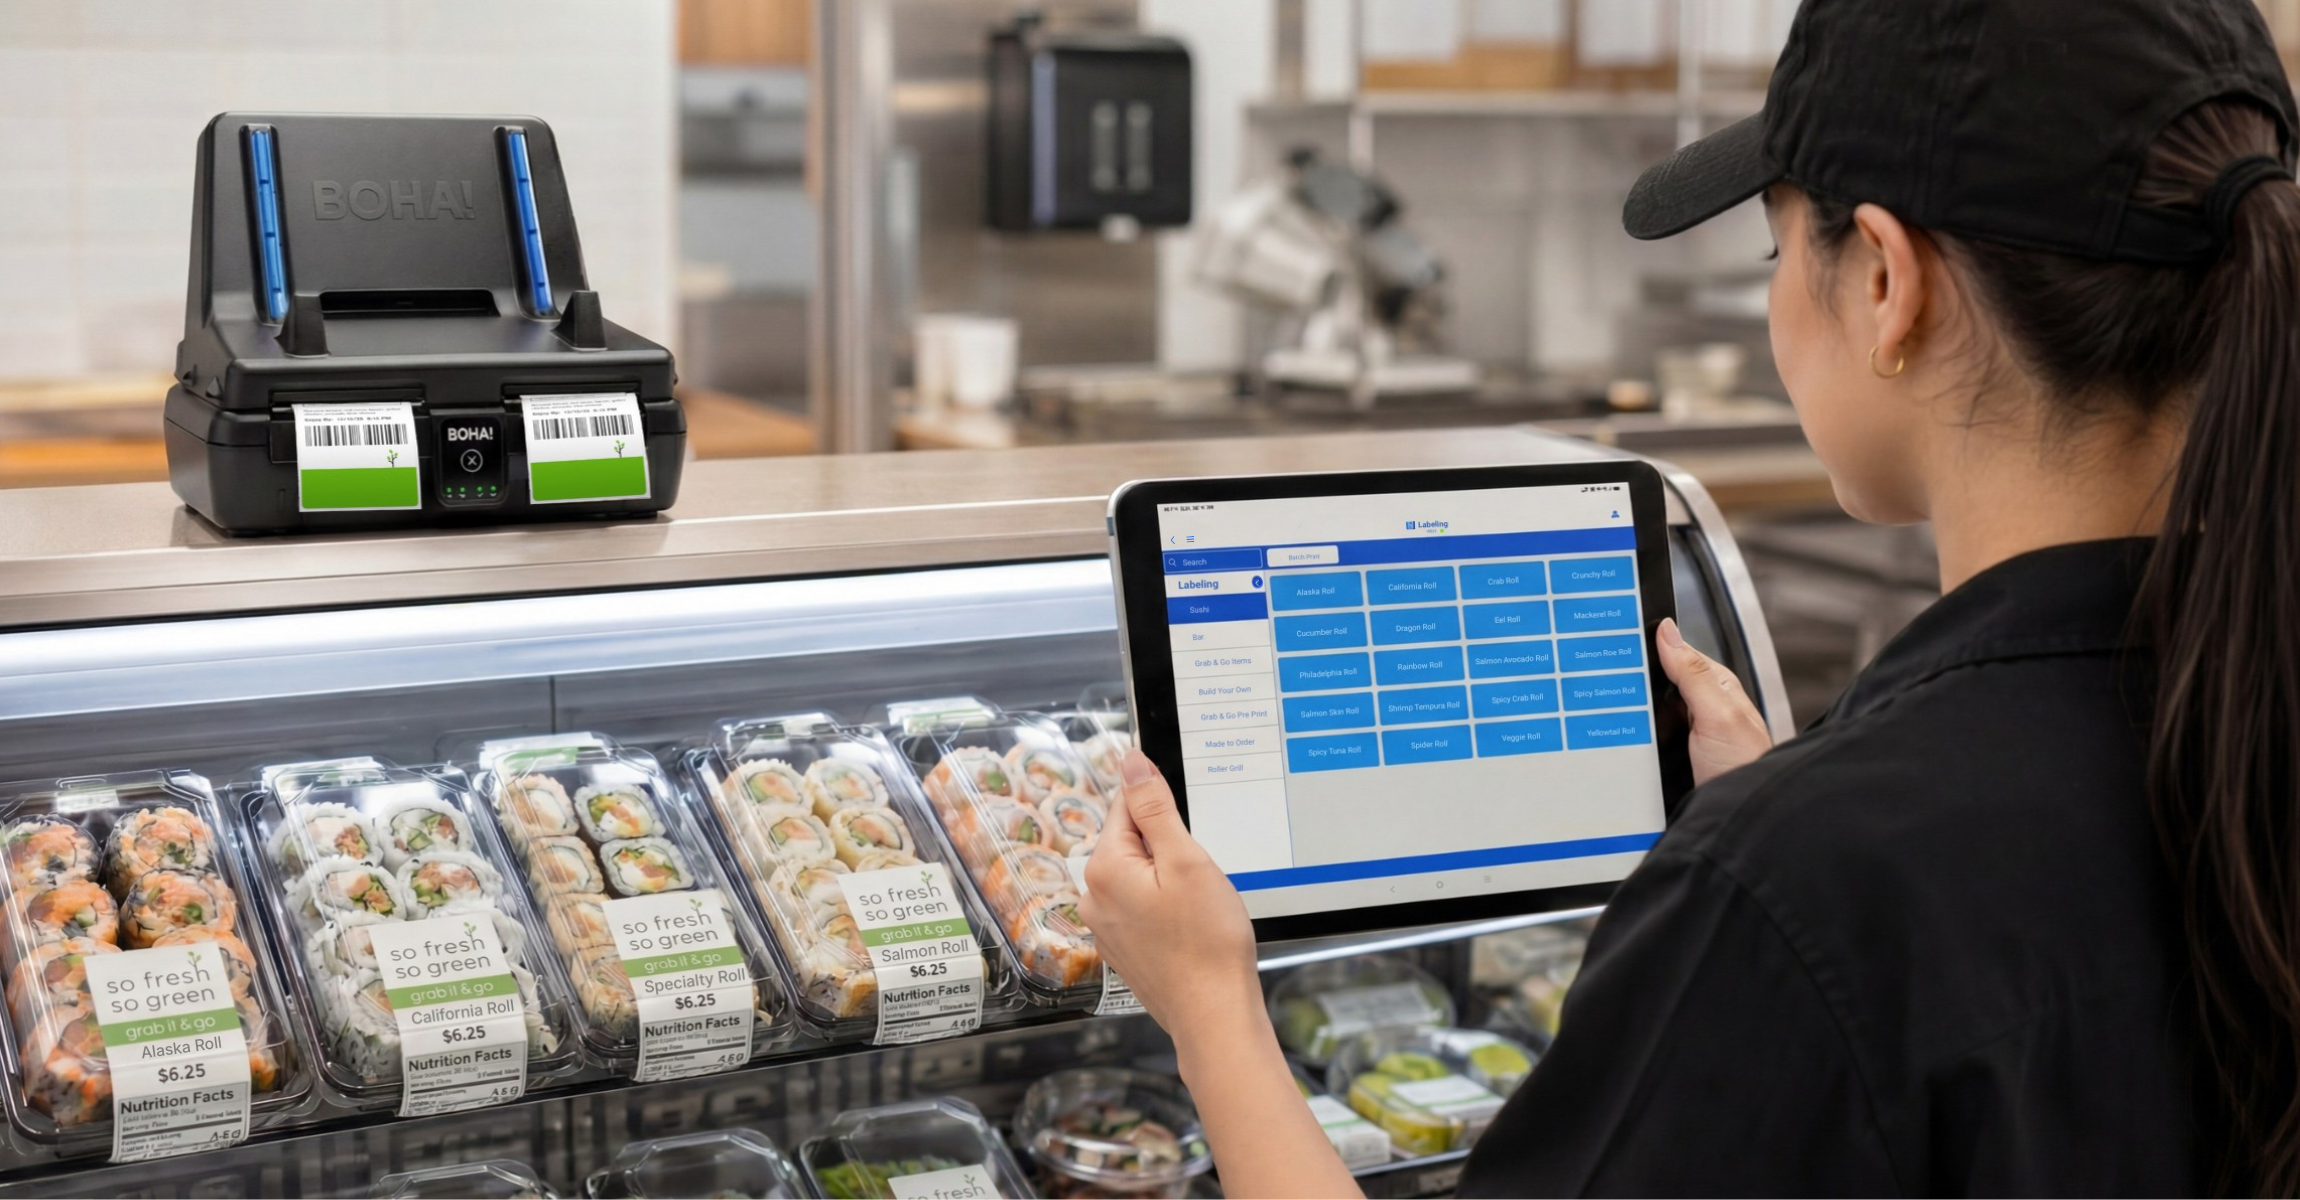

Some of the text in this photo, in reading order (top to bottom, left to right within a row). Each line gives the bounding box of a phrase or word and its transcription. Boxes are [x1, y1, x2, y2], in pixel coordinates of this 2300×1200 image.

[312, 180, 476, 220] BOHA!
[447, 427, 494, 441] BOHA!
[1182, 558, 1207, 567] Search
[1178, 580, 1219, 590] Labeling
[1572, 571, 1600, 580] Crunchy
[1574, 611, 1606, 619] Mackerel
[1297, 629, 1332, 637] Cucumber
[1396, 624, 1420, 633] Dragon
[1300, 670, 1342, 679] Philadelphia
[1398, 662, 1427, 671] Rainbow
[1492, 696, 1510, 705] Spicy
[1512, 694, 1529, 702] Crab
[1574, 690, 1593, 699] Spicy
[1301, 710, 1327, 718] Salmon
[1388, 704, 1413, 713] Shrimp
[1415, 703, 1445, 712] Tempura
[1502, 734, 1526, 743] Veggie
[1587, 729, 1620, 737] Yellowtail
[1308, 749, 1327, 757] Spicy
[1411, 742, 1433, 750] Spider
[859, 883, 942, 906] so fresh
[865, 901, 948, 921] so green
[623, 911, 712, 934] so fresh
[629, 930, 718, 950] so green
[881, 928, 912, 943] grab
[924, 925, 934, 935] &
[935, 924, 952, 937] go
[390, 937, 485, 961] so fresh
[882, 939, 969, 962] Salmon Roll
[395, 956, 491, 979] so green
[644, 958, 678, 974] grab
[690, 955, 701, 965] &
[703, 954, 722, 966] go
[910, 962, 947, 978] $6.25
[107, 966, 210, 994] so fresh
[644, 968, 745, 994] Specialty Roll
[111, 987, 215, 1013] so green
[410, 988, 447, 1004] grab
[460, 983, 472, 995] &
[473, 982, 493, 996] go
[675, 994, 716, 1010] $6.25
[884, 984, 971, 1004] Nutrition Facts
[411, 999, 514, 1024] California Roll
[126, 1023, 165, 1041] grab
[180, 1018, 192, 1030] &
[194, 1017, 216, 1031] go
[442, 1025, 486, 1044] $6.25
[645, 1016, 740, 1037] Nutrition Facts
[142, 1036, 222, 1059] Alaska Roll
[409, 1048, 512, 1072] Nutrition Facts
[158, 1063, 205, 1084] $6.25
[121, 1090, 234, 1114] Nutrition Facts
[934, 1181, 985, 1200] fresh
